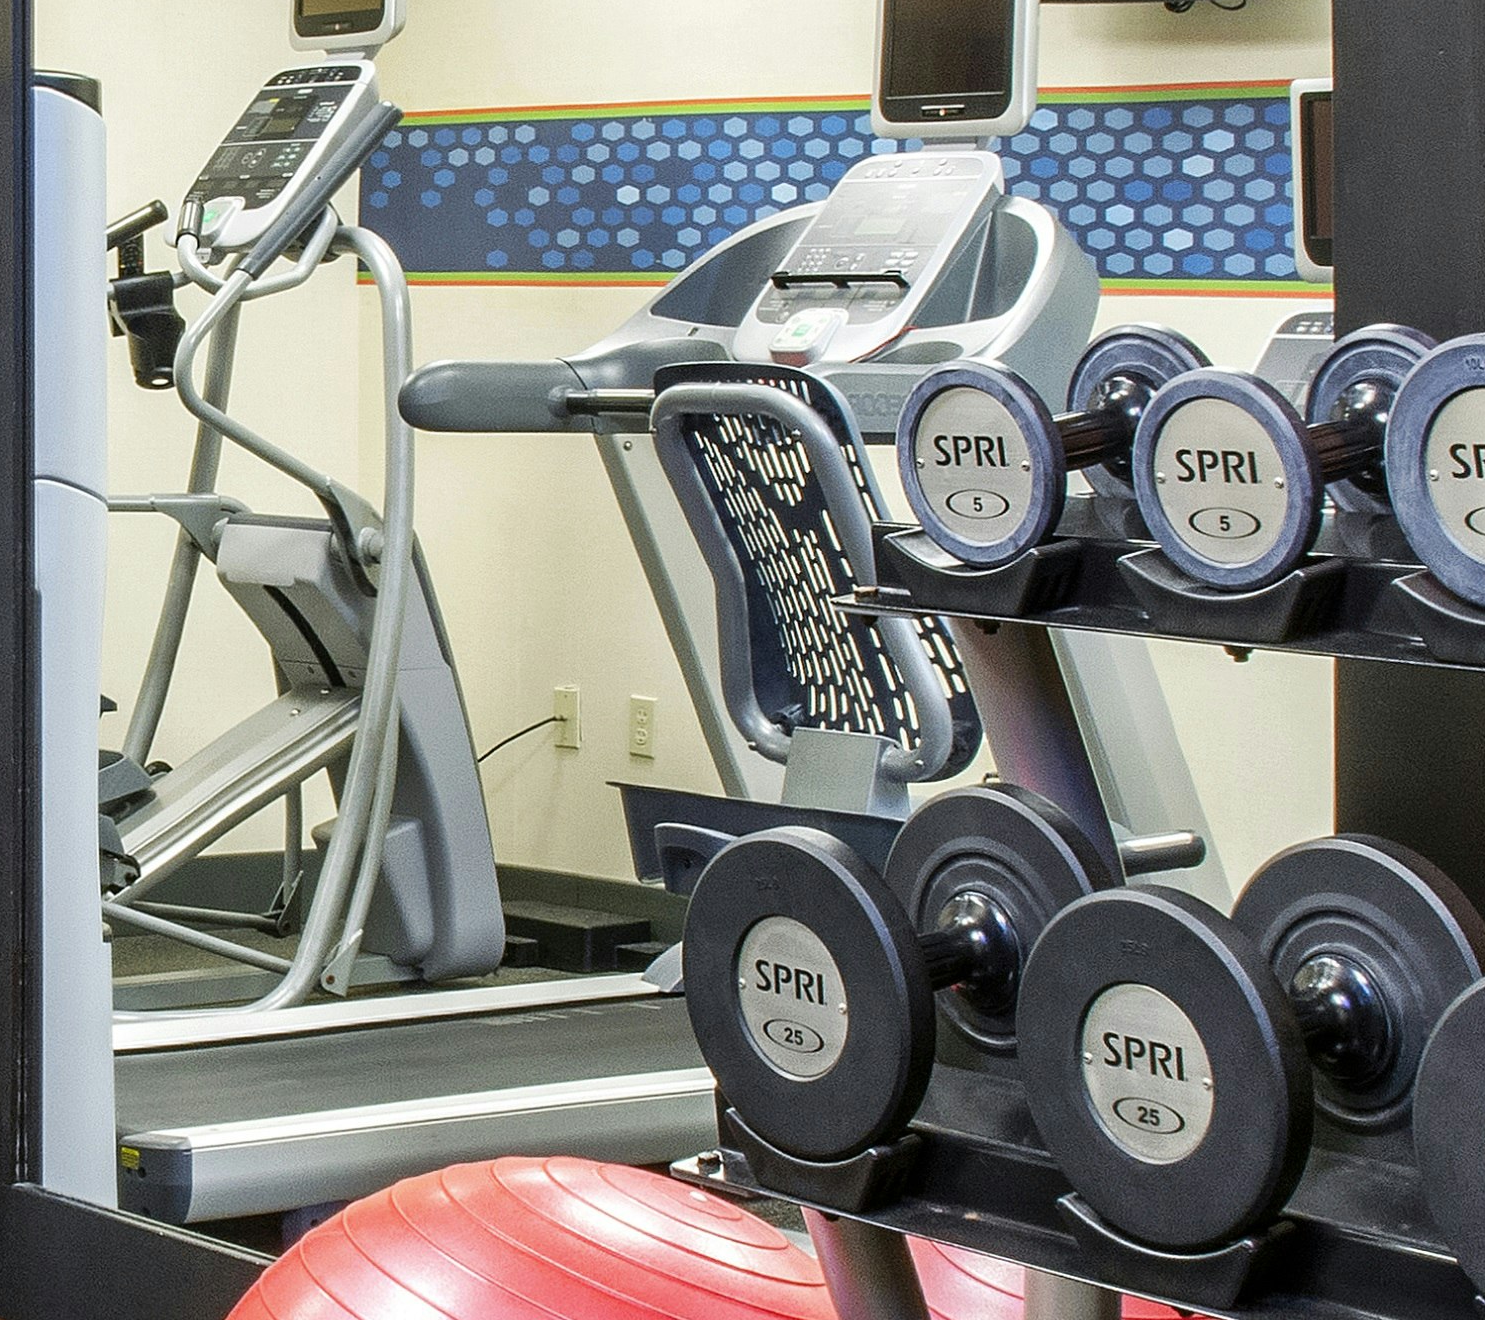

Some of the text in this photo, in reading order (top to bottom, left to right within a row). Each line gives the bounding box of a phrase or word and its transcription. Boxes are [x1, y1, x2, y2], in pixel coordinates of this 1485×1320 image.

[934, 435, 1010, 467] SPRI
[1176, 449, 1258, 484] SPRI
[973, 497, 983, 512] 5
[1220, 515, 1231, 532] 5
[755, 959, 824, 1005] SPRI
[784, 1027, 804, 1046] 25
[1103, 1032, 1184, 1081] SPRI
[1137, 1106, 1160, 1126] 25
